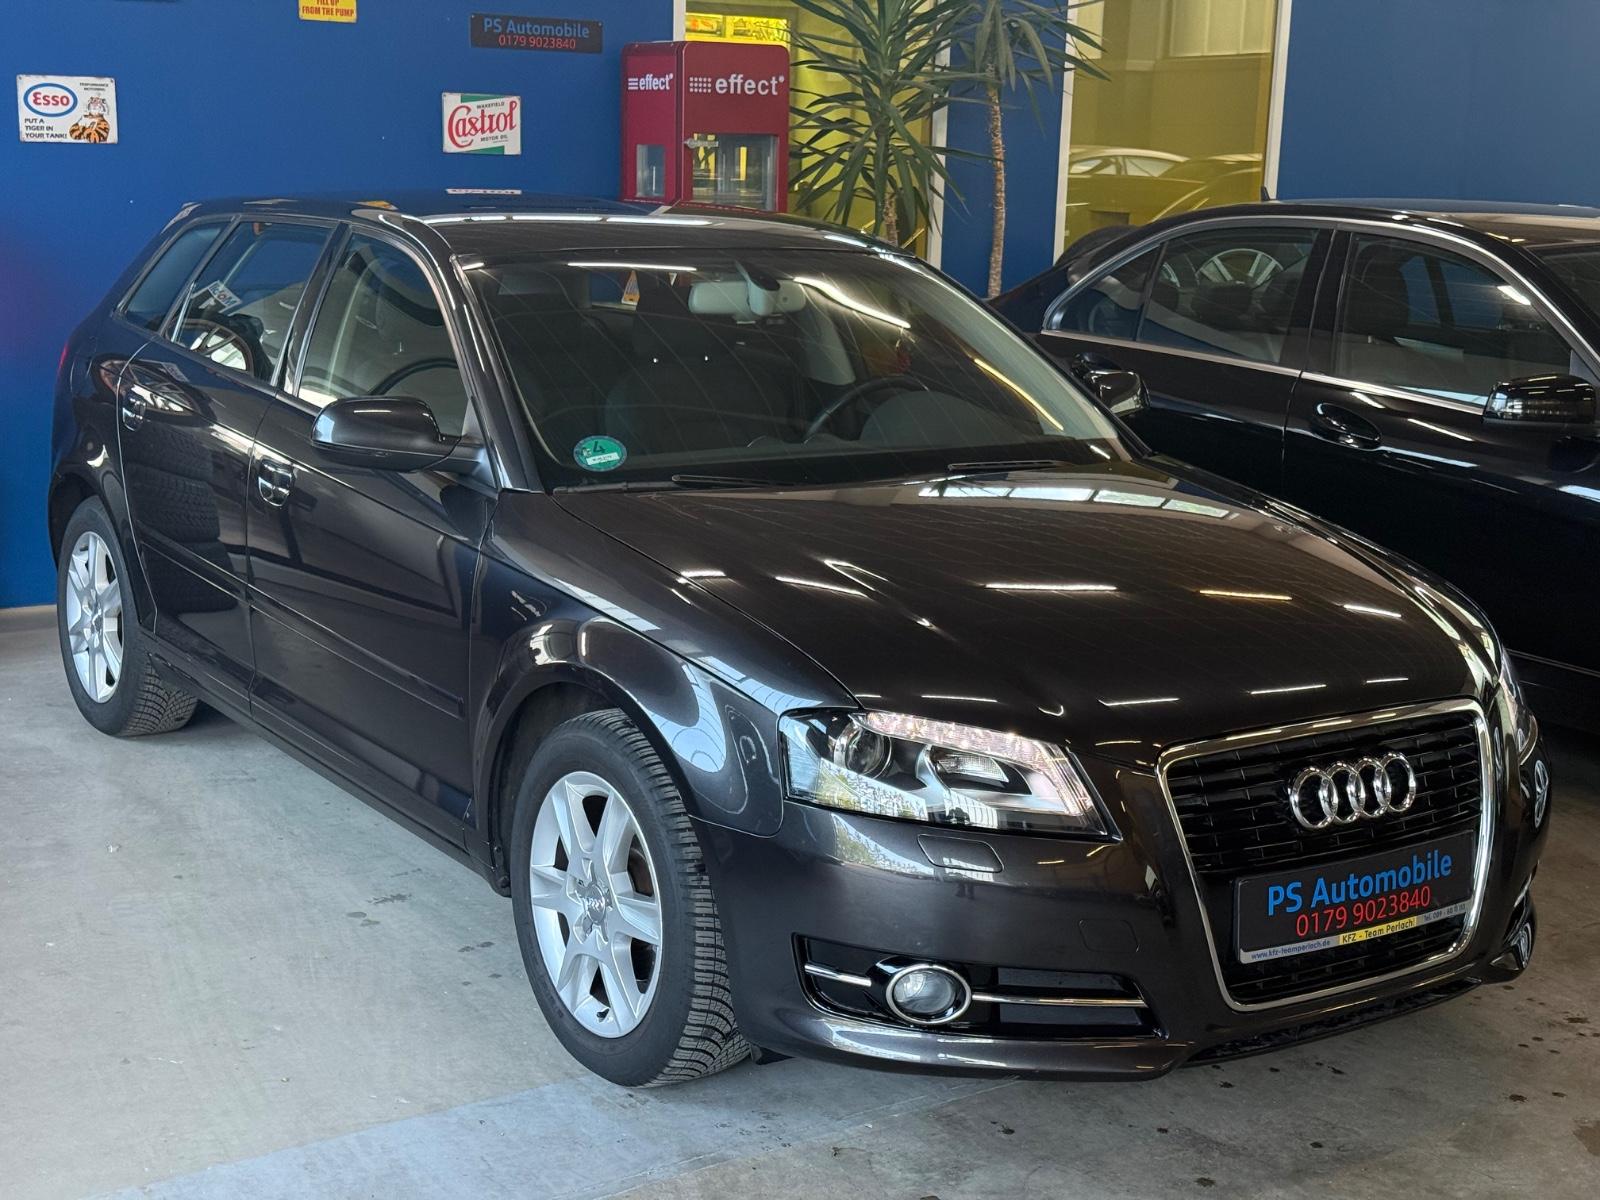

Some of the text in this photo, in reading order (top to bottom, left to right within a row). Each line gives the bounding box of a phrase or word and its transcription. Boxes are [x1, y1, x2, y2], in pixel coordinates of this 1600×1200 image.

[302, 6, 354, 16] FROM THE PUMP
[483, 18, 590, 37] PS Automobile
[498, 34, 576, 49] 0179 9023840
[639, 74, 670, 90] effect
[715, 74, 779, 95] effect
[476, 101, 505, 109] WAKEFIELD
[447, 100, 518, 148] Castrol
[1268, 849, 1452, 916] PS Automobile
[1296, 885, 1431, 937] 0179 9023840
[1342, 932, 1357, 943] KFZ
[1364, 928, 1385, 938] Team
